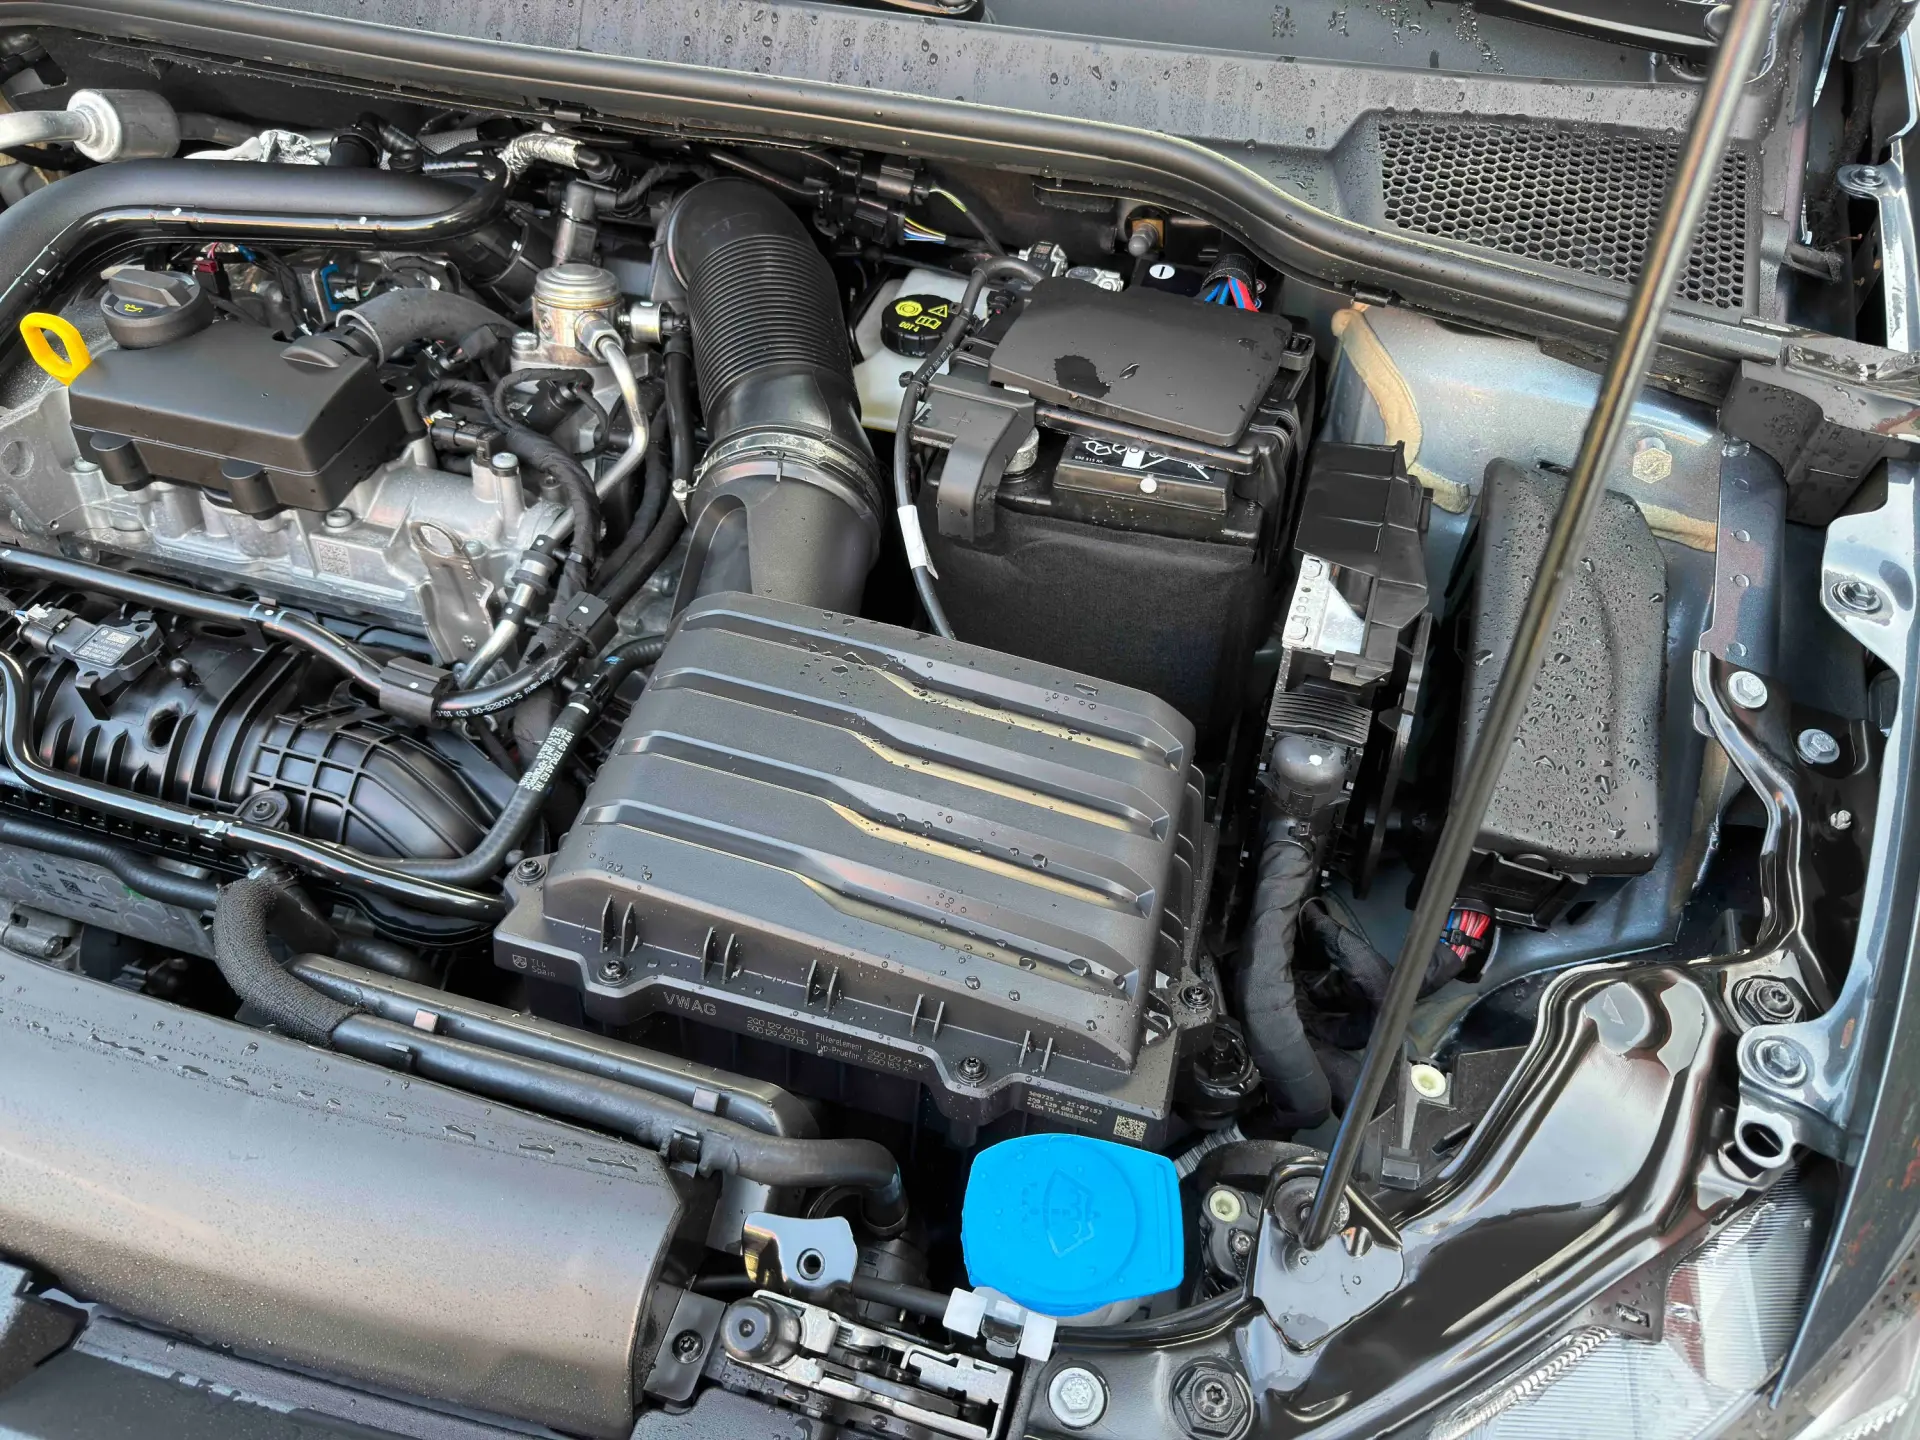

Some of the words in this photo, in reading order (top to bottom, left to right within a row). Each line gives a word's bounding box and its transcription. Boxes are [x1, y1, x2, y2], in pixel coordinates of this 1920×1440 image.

[898, 321, 915, 331] DOT
[562, 730, 574, 743] VW
[557, 739, 568, 751] AG
[544, 749, 563, 773] TEKLAS
[531, 965, 556, 978] Spain
[663, 991, 717, 1016] VWAG
[815, 1032, 863, 1051] Filterelement
